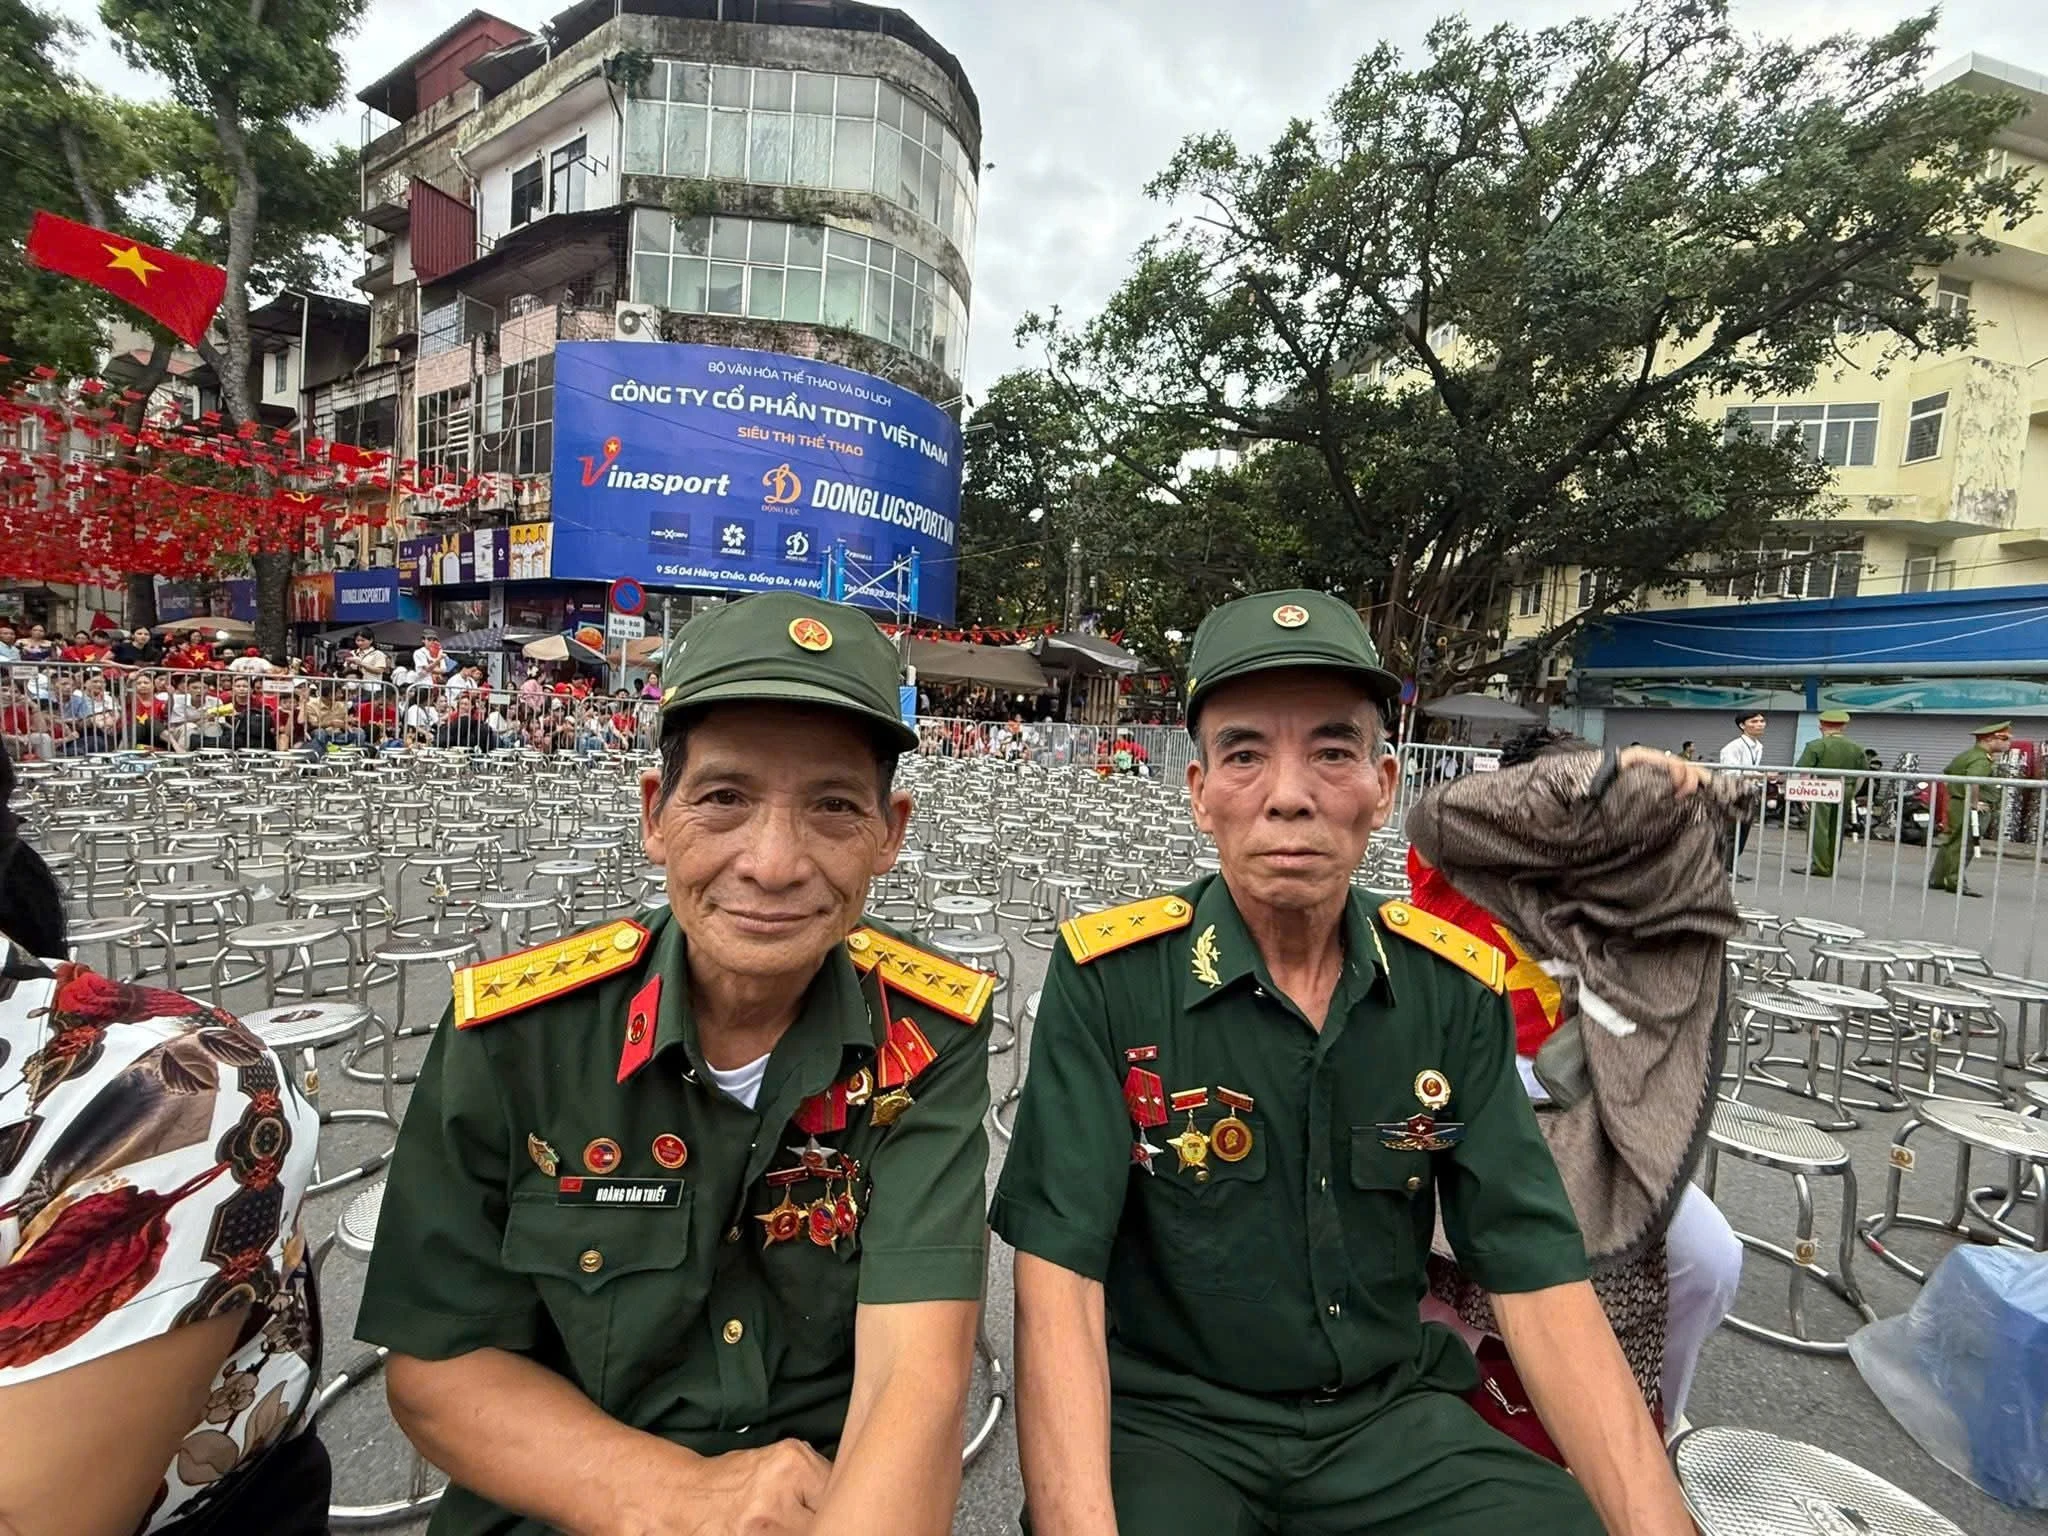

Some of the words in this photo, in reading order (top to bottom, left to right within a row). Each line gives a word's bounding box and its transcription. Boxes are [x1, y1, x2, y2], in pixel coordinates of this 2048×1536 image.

[708, 361, 726, 374] BỘ
[728, 363, 752, 377] VĂN
[754, 367, 779, 380] HÓA
[806, 375, 837, 391] THAO
[839, 383, 853, 395] VÀ
[855, 388, 869, 400] DU
[871, 394, 892, 407] LỊCH
[610, 379, 671, 404] CÔNG
[676, 387, 709, 406] TY
[712, 384, 745, 411] CỔ
[749, 392, 816, 422] PHẦN
[820, 406, 877, 435] TDTT
[880, 421, 919, 449] VIỆT
[920, 437, 949, 467] NAM
[737, 426, 769, 441] SIÊU
[772, 431, 795, 446] THỊ
[827, 440, 864, 457] THAO
[577, 436, 731, 496] Vinasport
[811, 479, 955, 547] DONGLUCSPORT.VN
[664, 564, 677, 575] Số
[693, 567, 719, 580] Hàng
[1788, 786, 1818, 797] DỪNG
[1820, 789, 1839, 799] LẠI
[595, 1185, 626, 1202] HOÀNG
